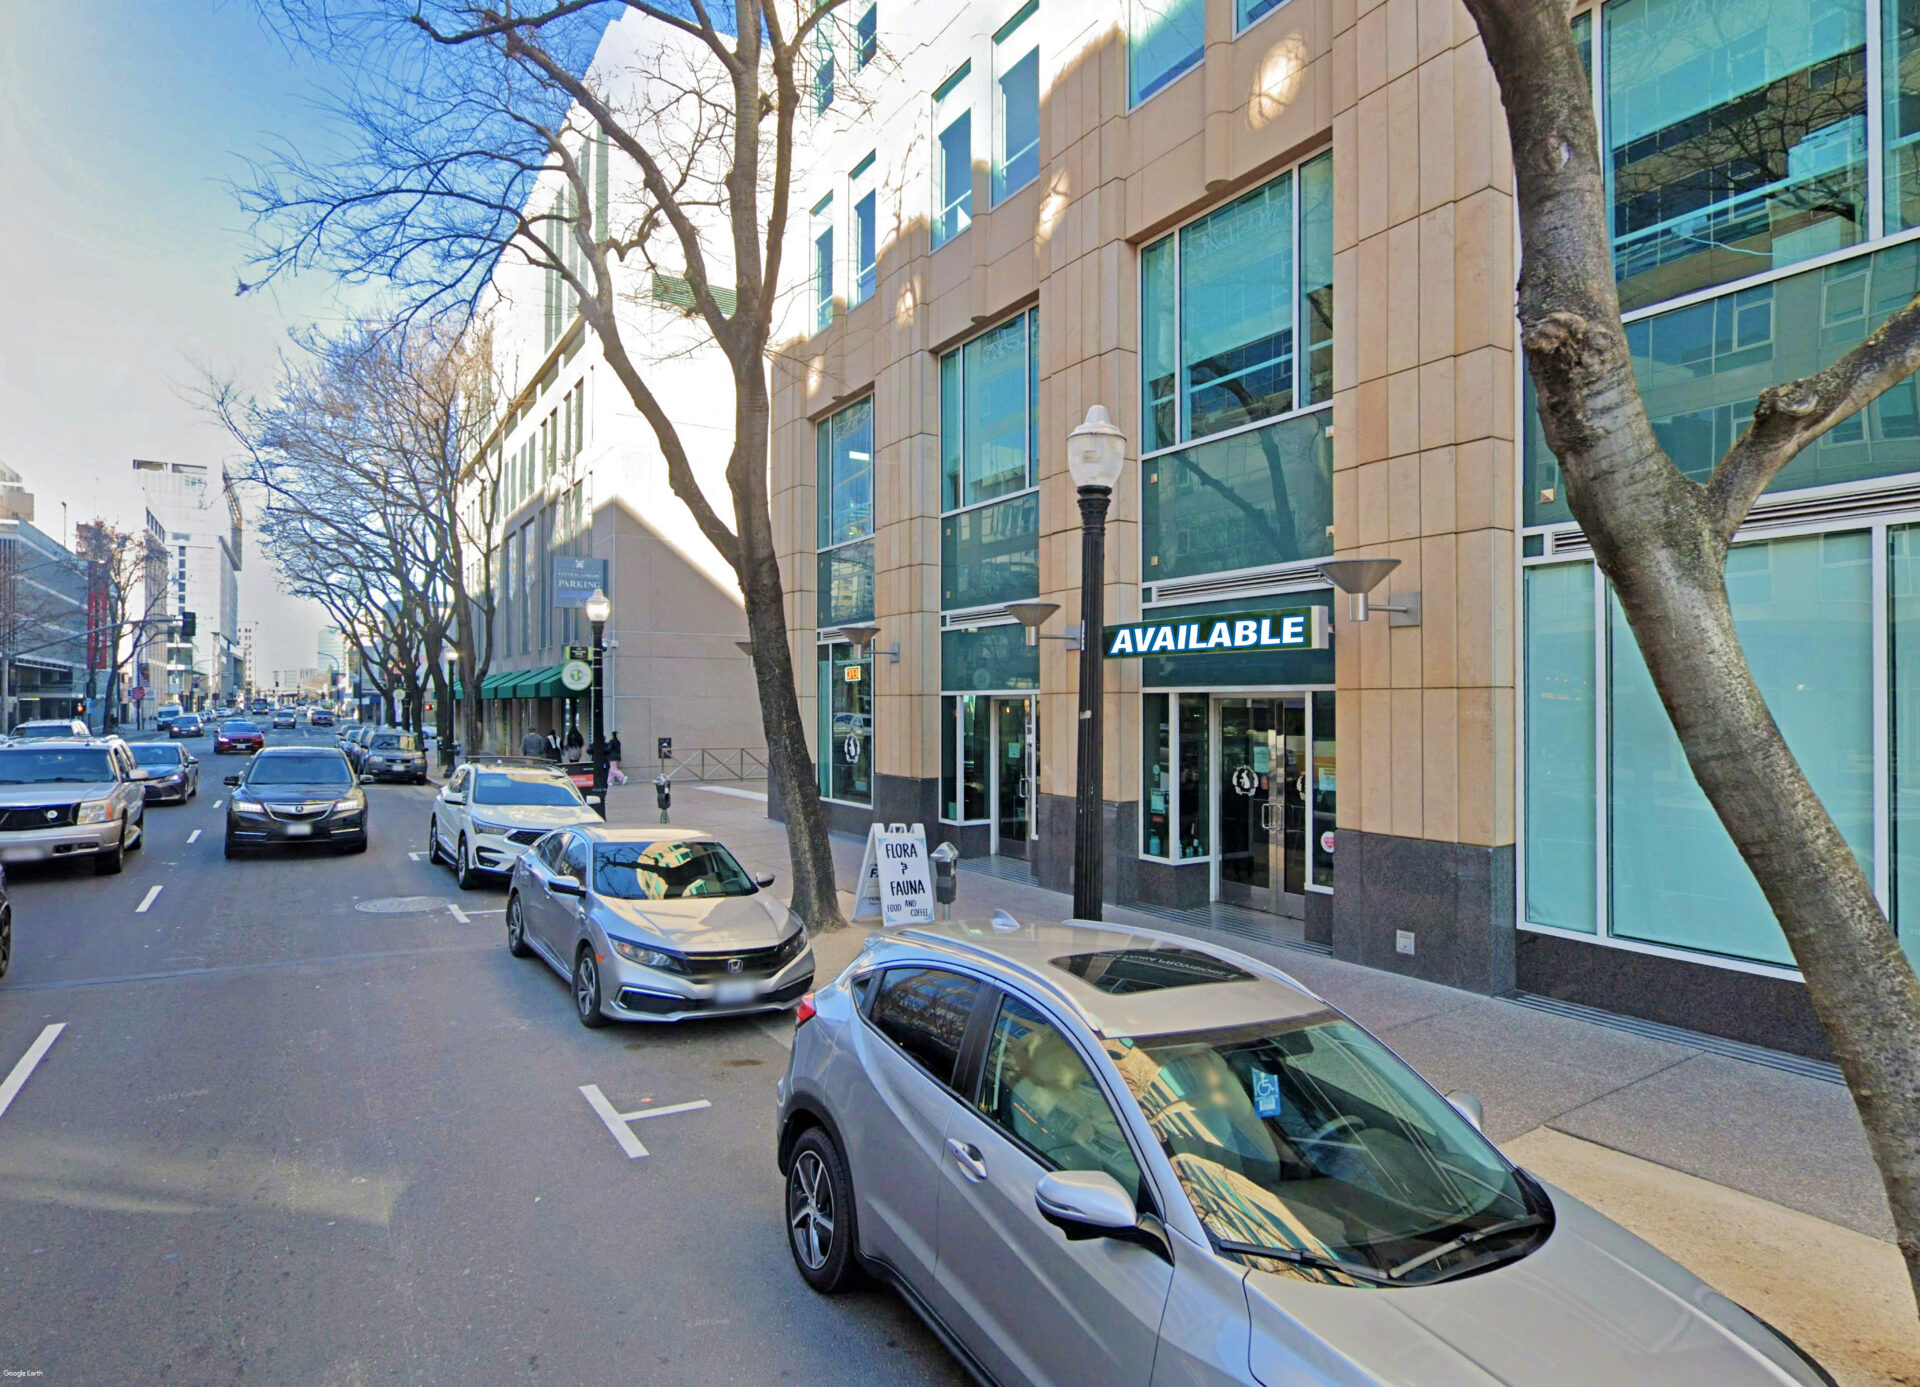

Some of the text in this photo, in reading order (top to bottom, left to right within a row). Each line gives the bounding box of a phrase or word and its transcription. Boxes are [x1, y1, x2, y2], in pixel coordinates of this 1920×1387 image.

[558, 579, 601, 589] PARKING
[1110, 615, 1305, 655] AVAILABLE
[885, 843, 918, 858] FLORA
[890, 880, 925, 896] FAUNA
[886, 900, 929, 917] FOOD AND COFFEE
